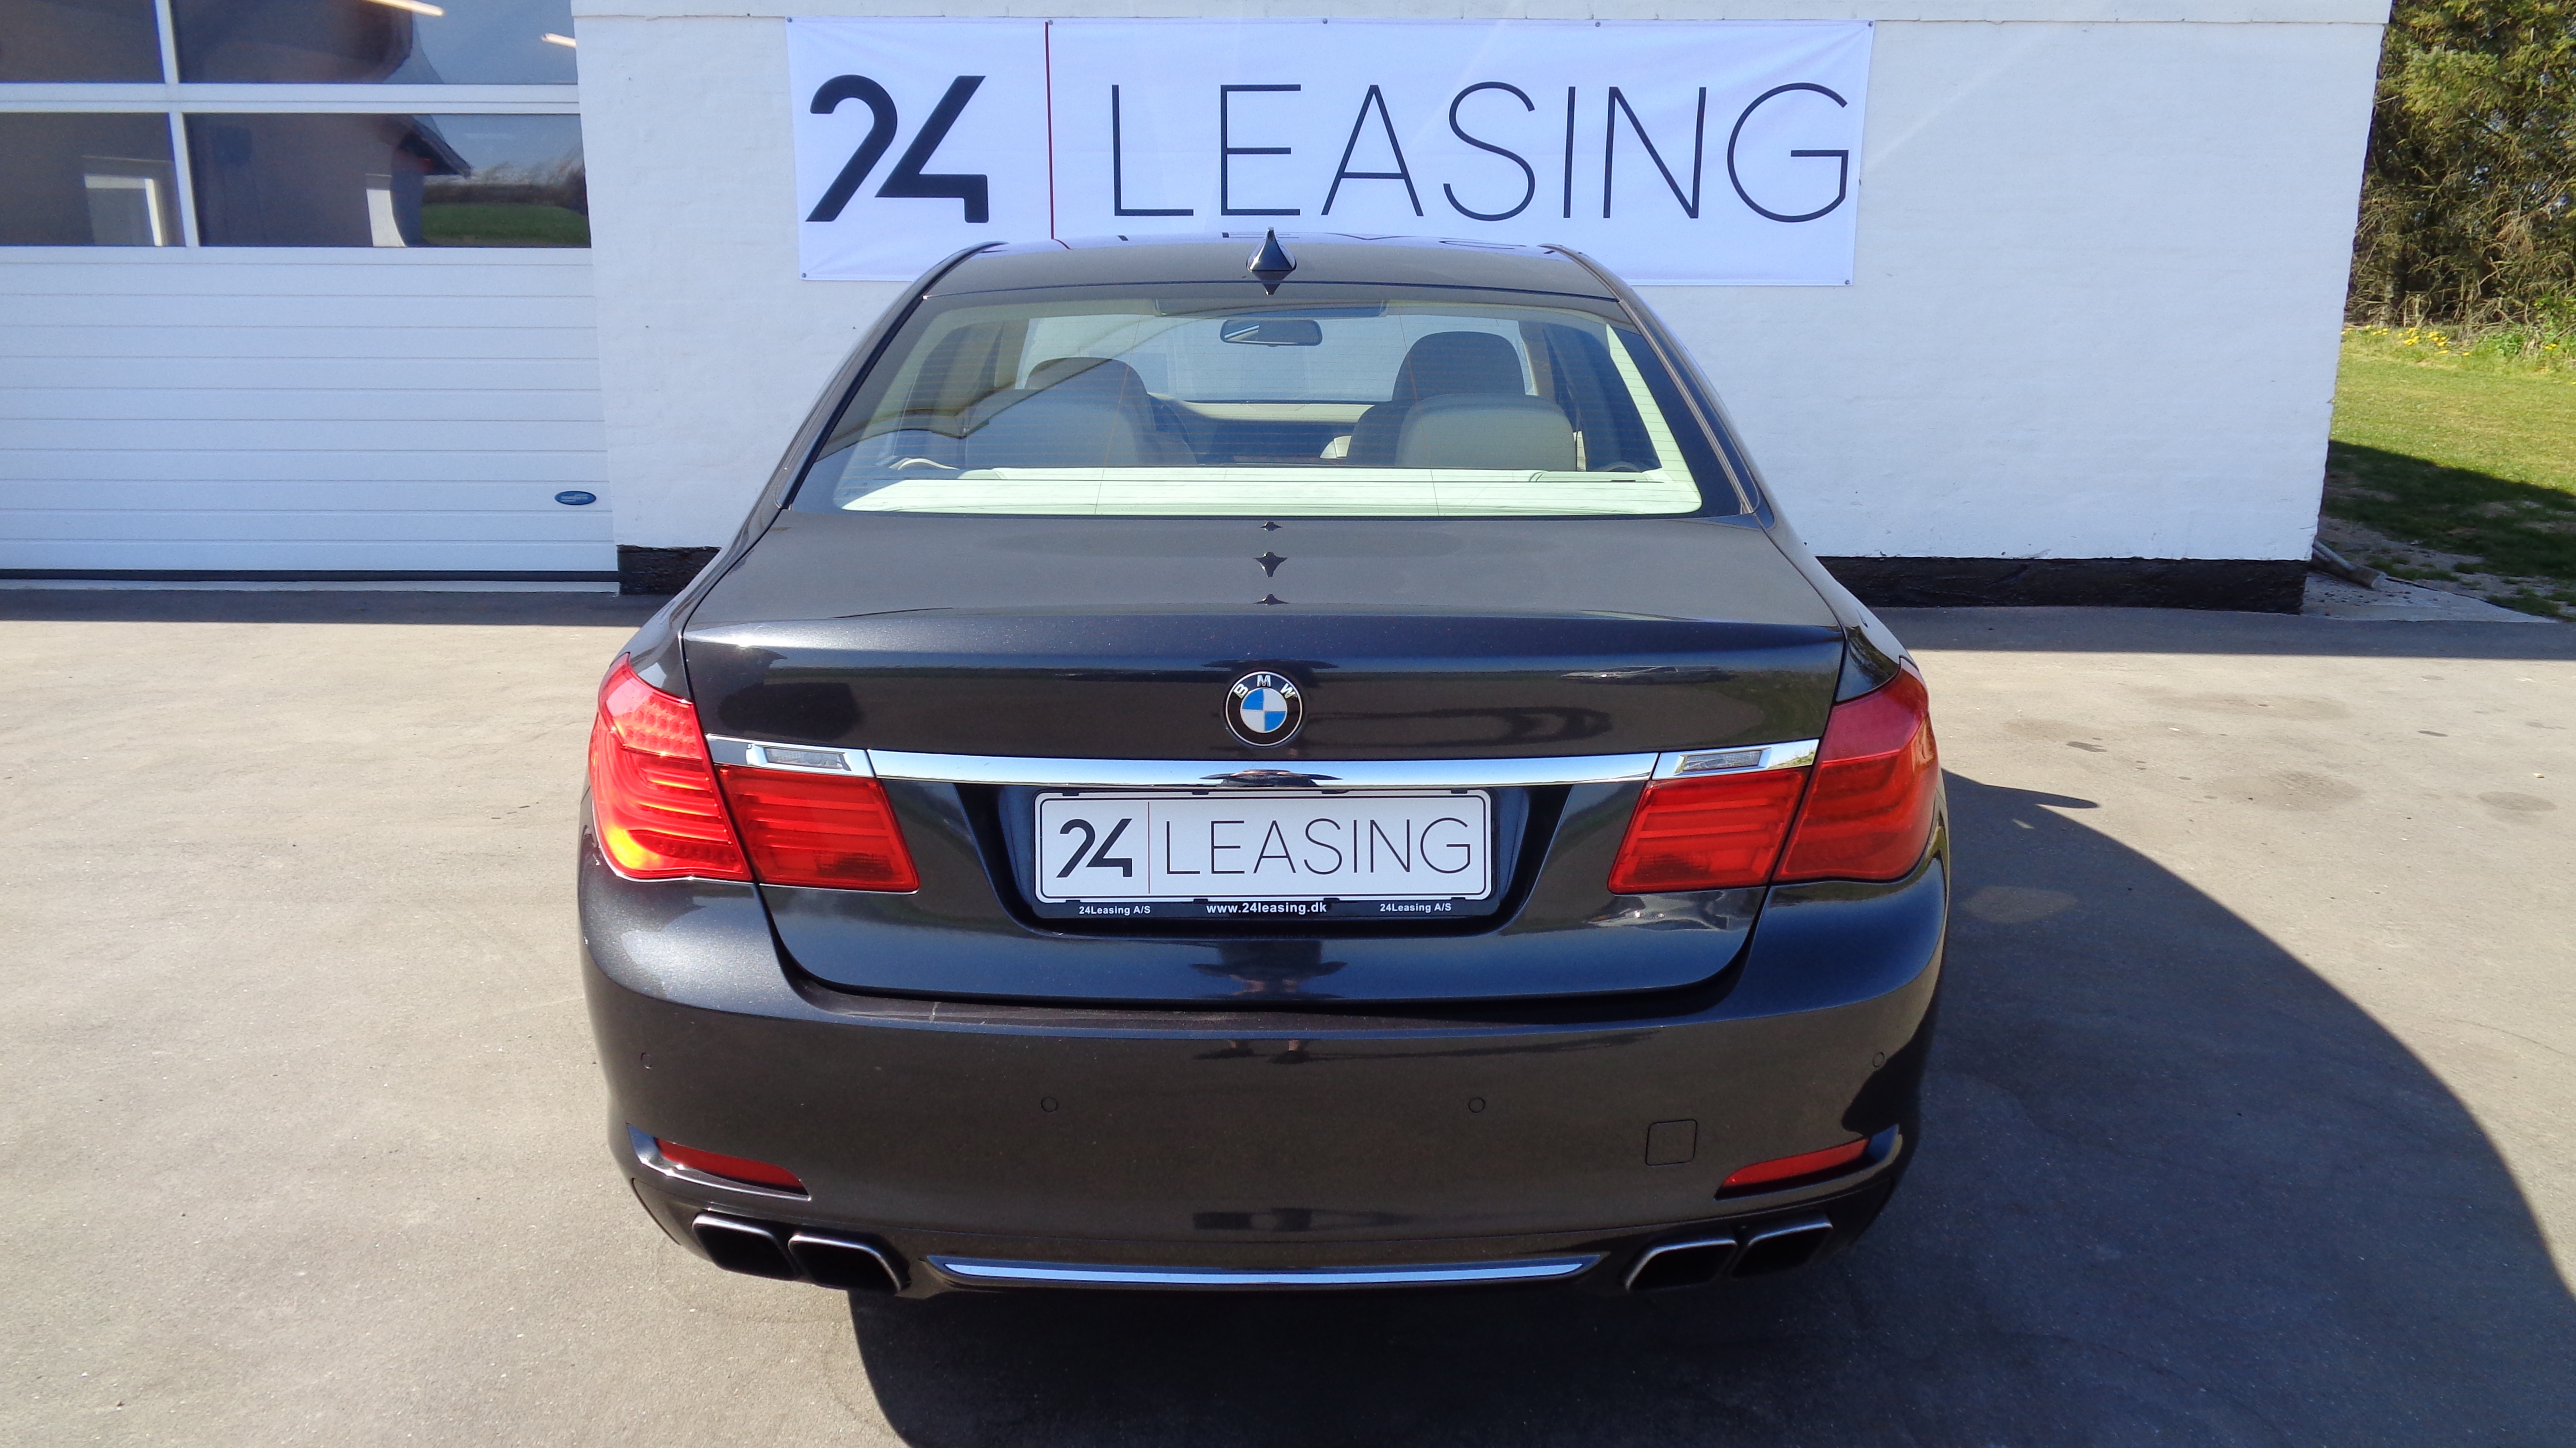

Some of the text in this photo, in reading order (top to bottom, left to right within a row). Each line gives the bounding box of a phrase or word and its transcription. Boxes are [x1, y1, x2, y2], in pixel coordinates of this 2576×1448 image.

[806, 74, 1850, 224] 24 LEASING
[1233, 674, 1298, 699] BMW
[1056, 817, 1471, 878] 24 LEASING
[1078, 905, 1151, 916] 24Leasing A/S
[1206, 902, 1328, 915] www.24leasing.dk
[1380, 902, 1452, 914] 24Leasing A/S
